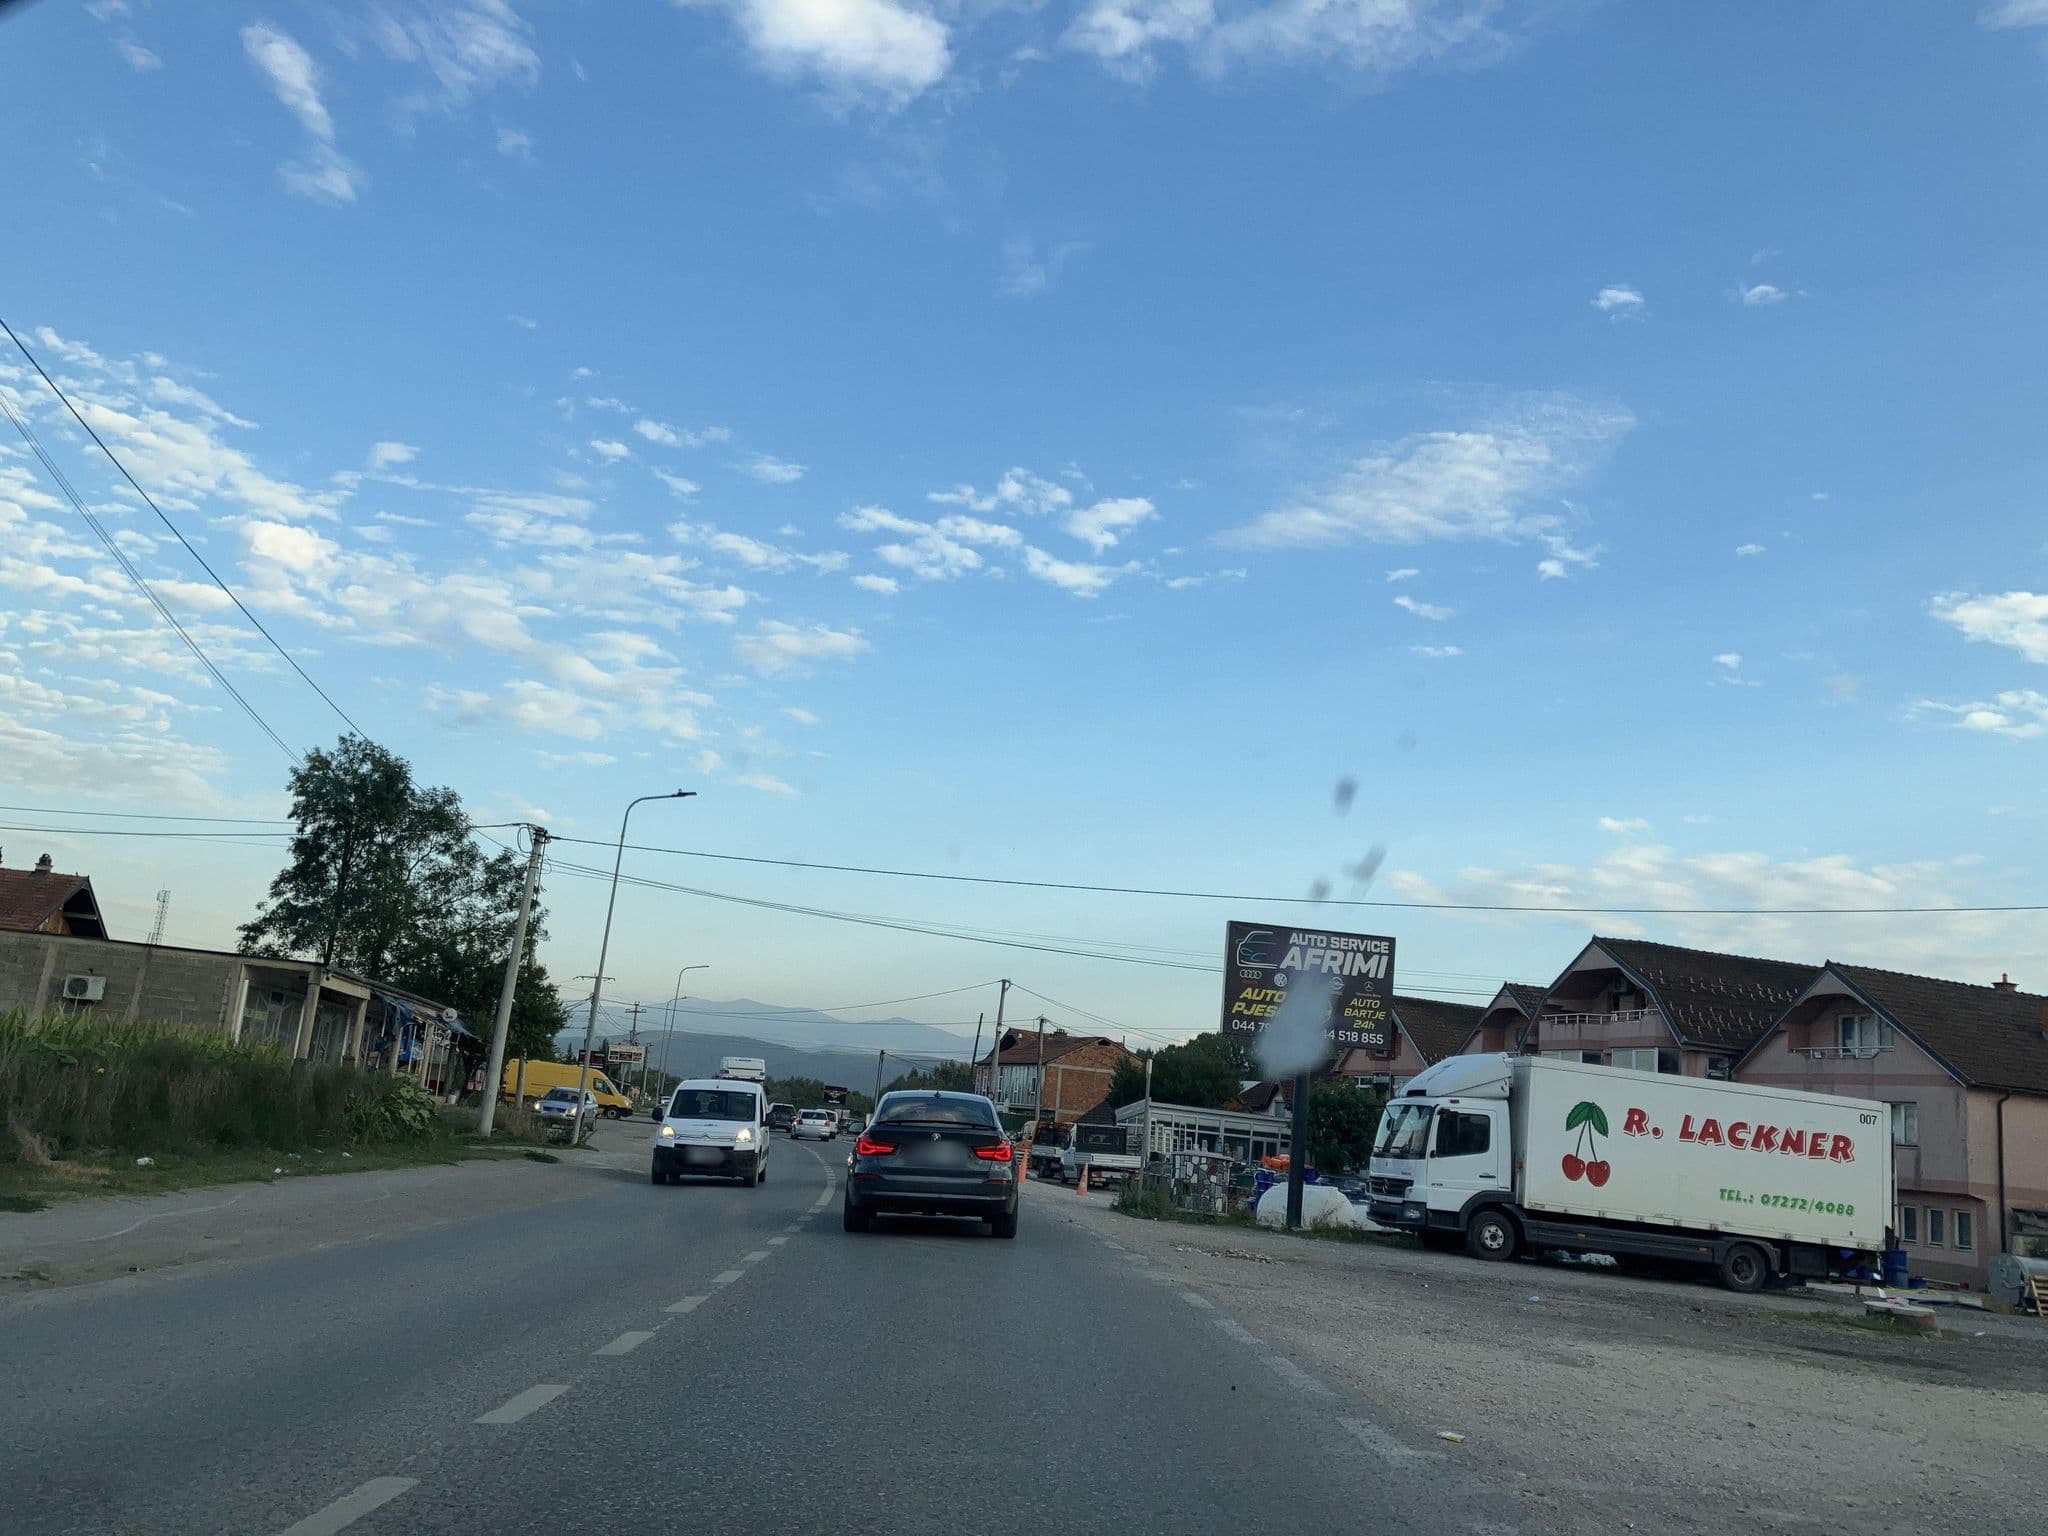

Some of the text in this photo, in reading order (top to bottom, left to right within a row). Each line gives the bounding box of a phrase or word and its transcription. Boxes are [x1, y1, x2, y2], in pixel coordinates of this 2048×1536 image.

[1289, 932, 1389, 954] AUTO SERVICE
[1280, 946, 1388, 979] AFRIMI
[1240, 987, 1287, 1003] AUTO
[1232, 1002, 1279, 1018] PJES
[1349, 998, 1380, 1009] AUTO
[1343, 1007, 1386, 1020] BARTJE
[1232, 1019, 1255, 1032] 044
[1353, 1019, 1375, 1030] 24h
[1339, 1031, 1358, 1042] 518
[1361, 1033, 1384, 1045] 855
[1859, 1113, 1877, 1126] 007
[1623, 1107, 1855, 1164] R. LACKNER
[1719, 1188, 1855, 1217] TEL.: 07272/4088
